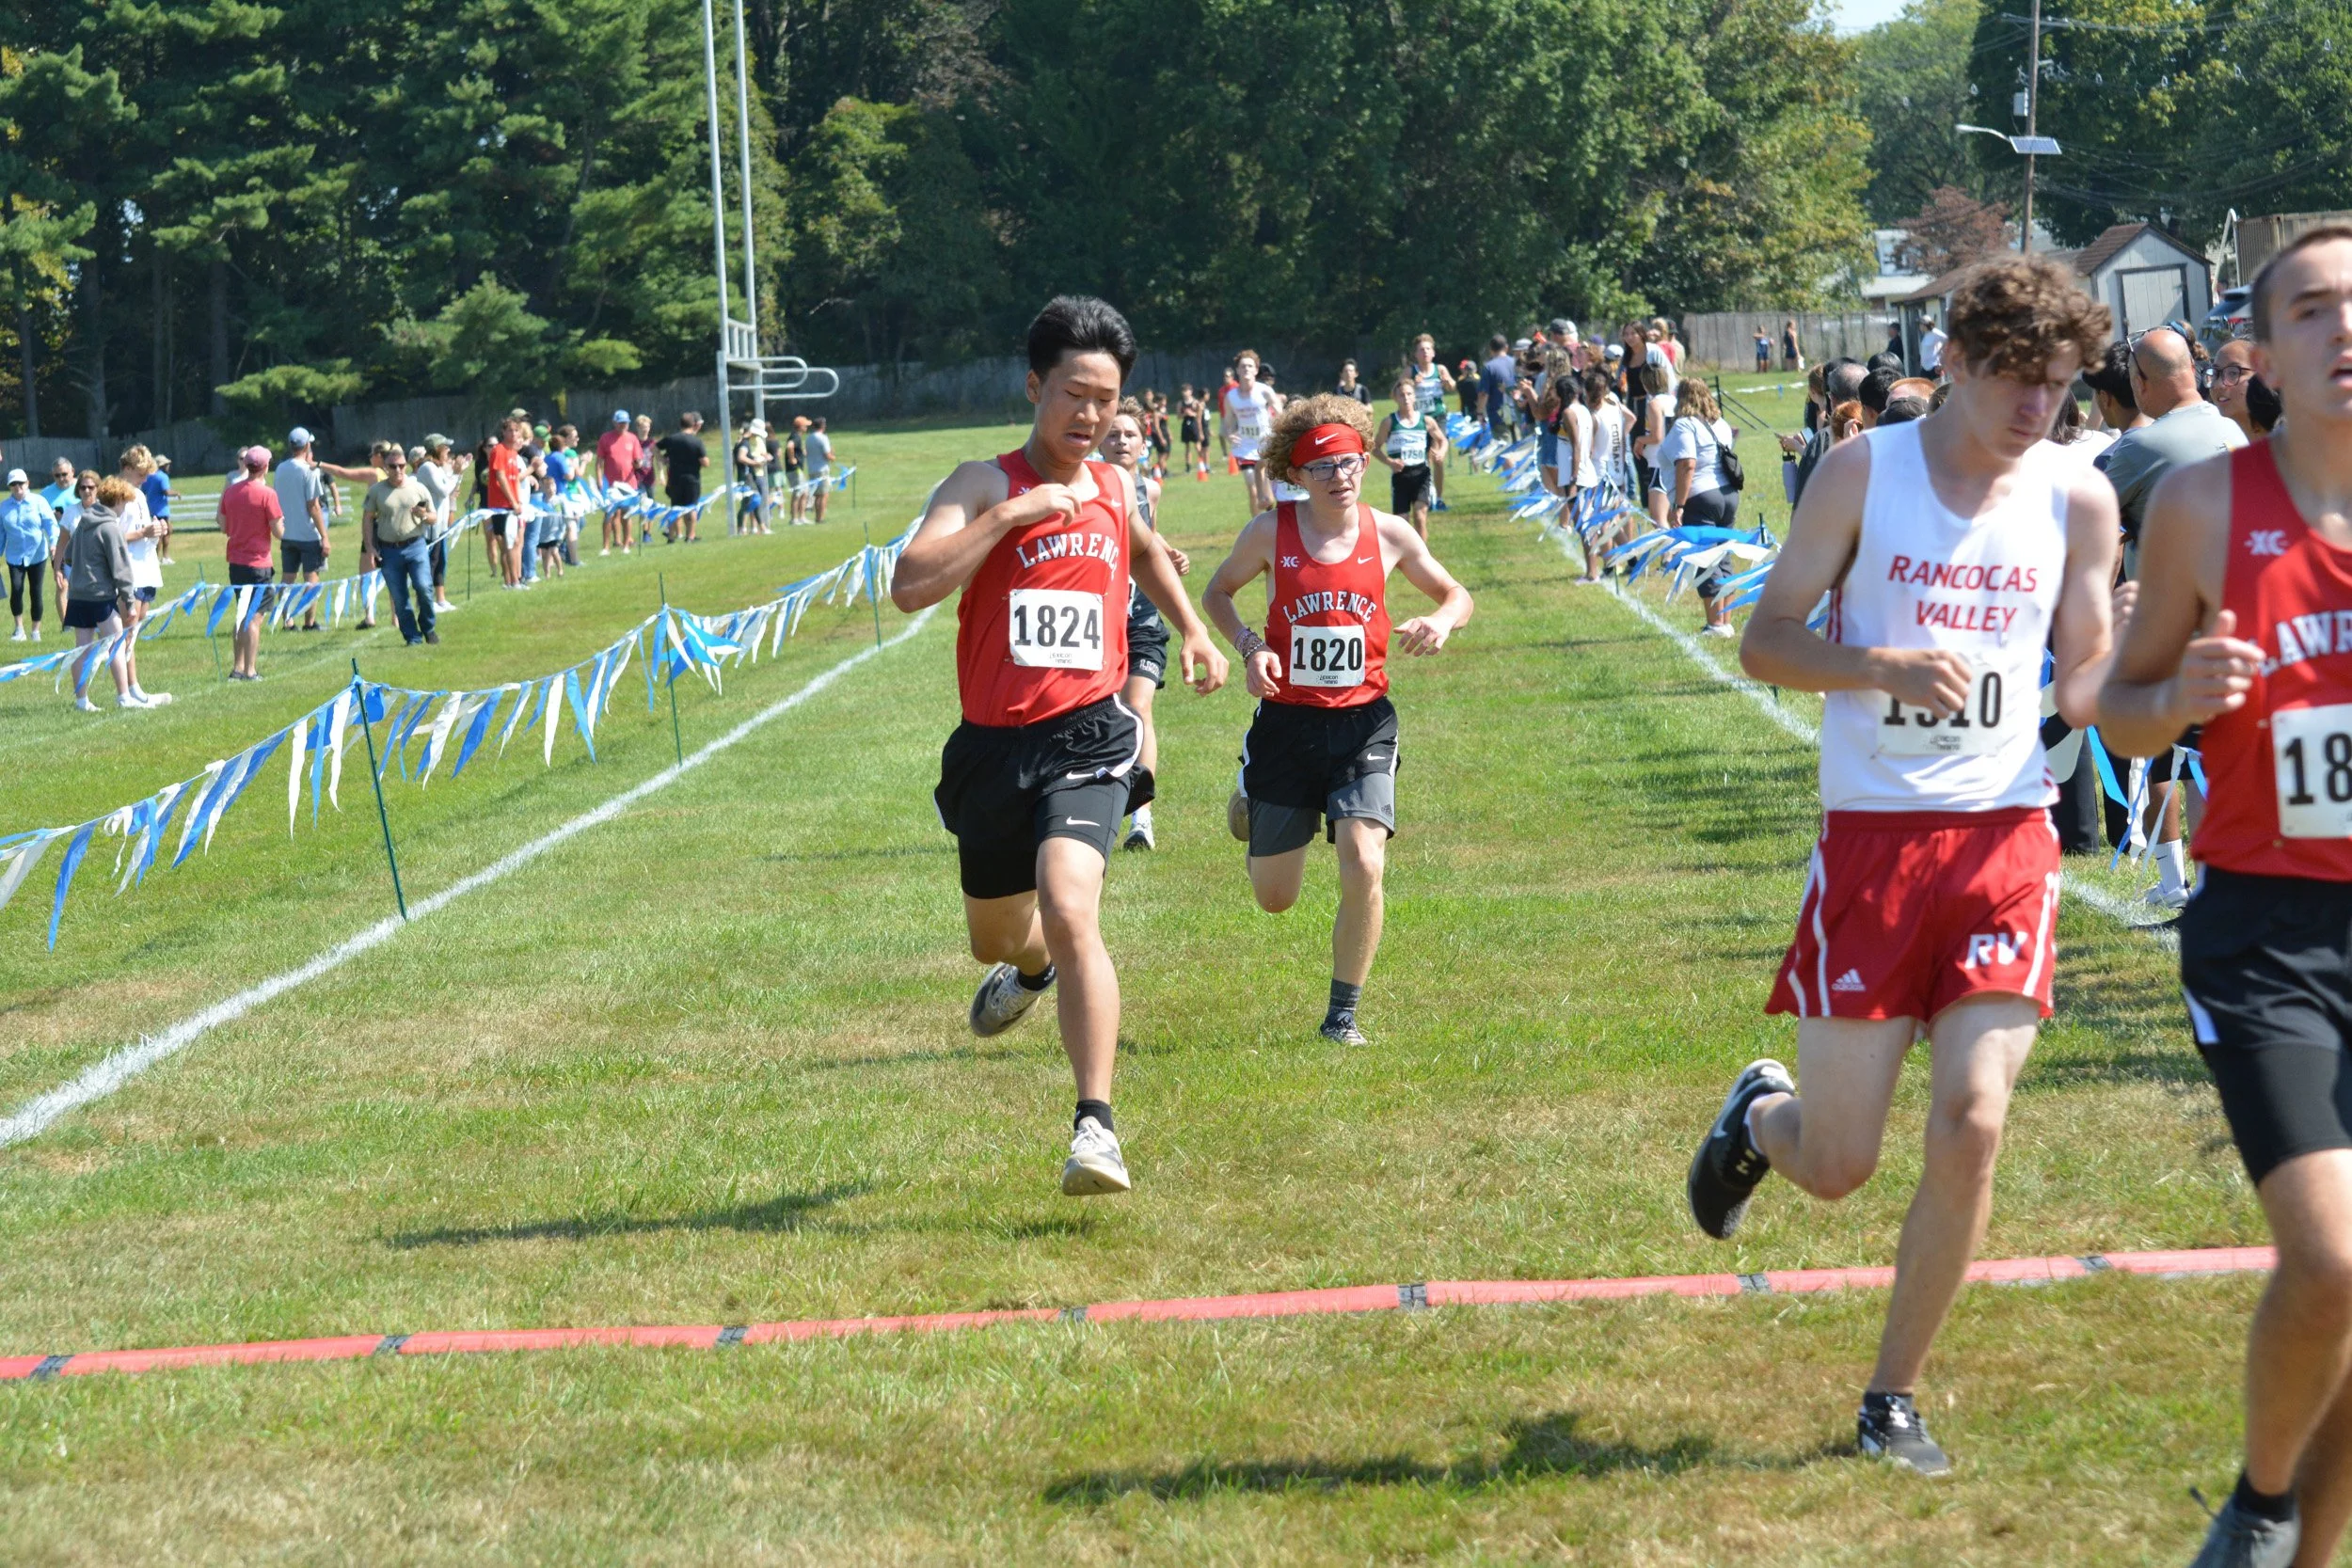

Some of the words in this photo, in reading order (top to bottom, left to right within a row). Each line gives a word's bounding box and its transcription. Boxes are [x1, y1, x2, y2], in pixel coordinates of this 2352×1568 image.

[1281, 556, 1299, 567] XC
[1887, 555, 2038, 593] RANCOCAS
[1282, 590, 1377, 624] LAWRENCE
[1915, 599, 2017, 633] VALLEY
[1013, 604, 1102, 650] 1824
[1293, 637, 1362, 672] 1820
[1963, 932, 2028, 970] RV
